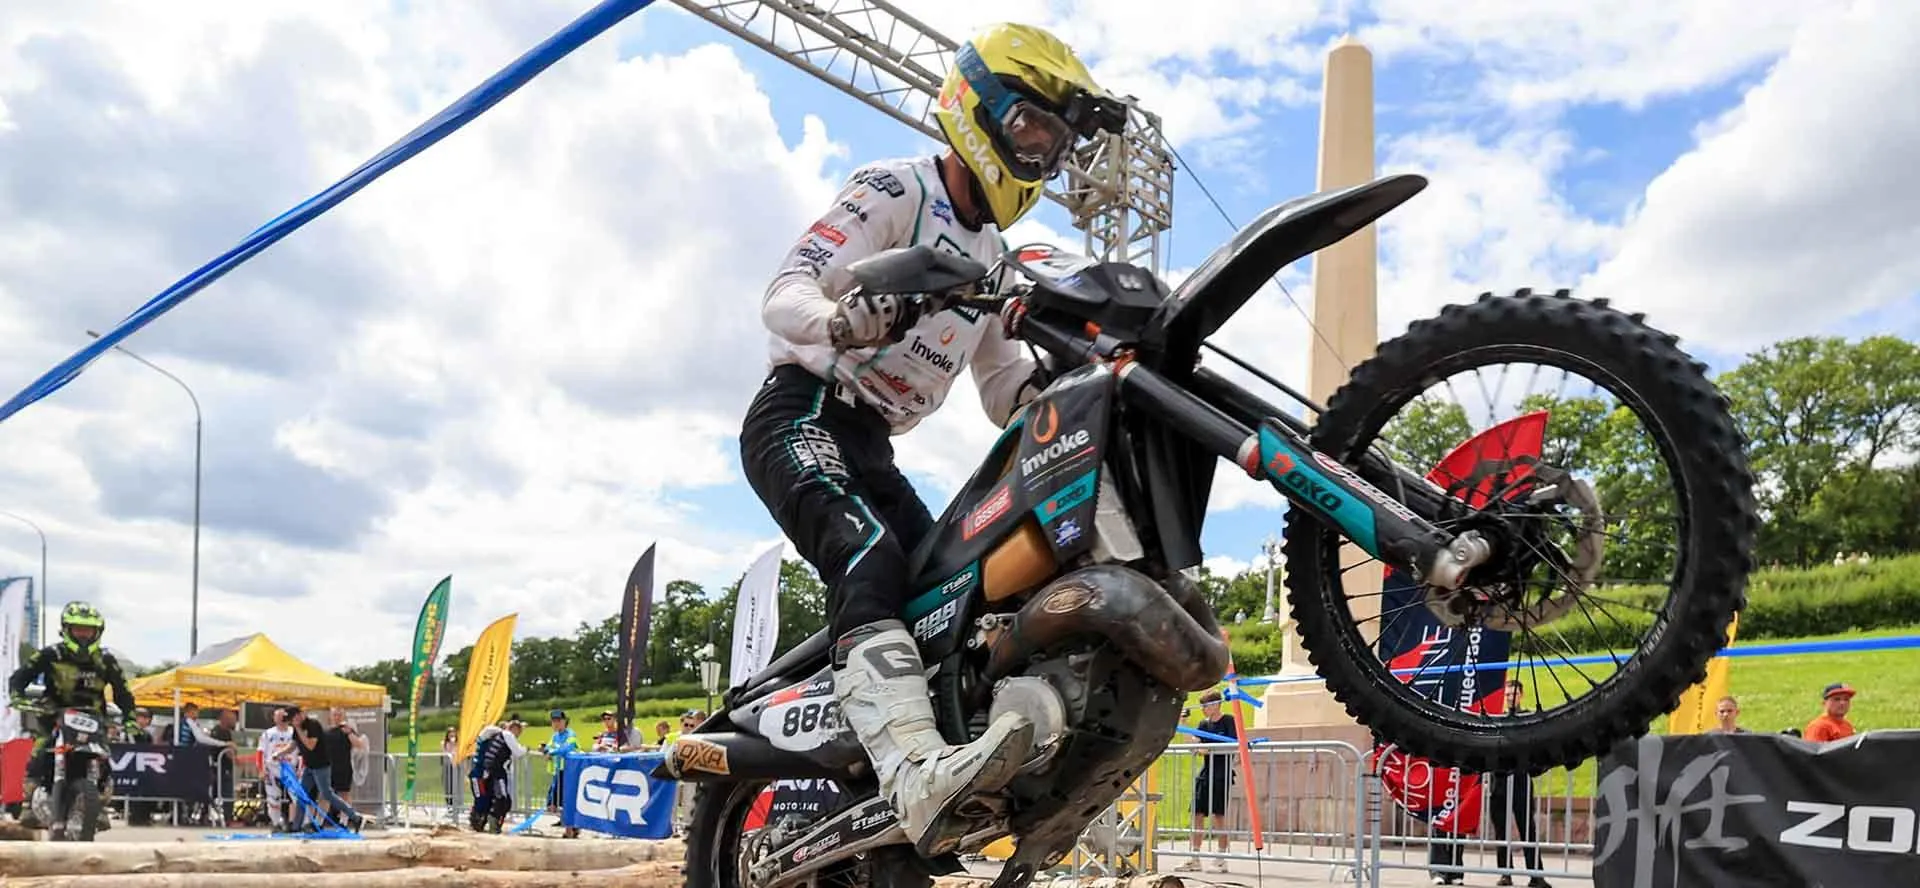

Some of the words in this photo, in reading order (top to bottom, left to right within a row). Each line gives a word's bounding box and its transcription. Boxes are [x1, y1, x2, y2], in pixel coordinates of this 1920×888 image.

[911, 335, 953, 374] invoke
[1021, 430, 1090, 476] invoke
[922, 620, 950, 641] TEAM
[108, 751, 166, 774] VR
[577, 765, 652, 826] GR
[1779, 800, 1920, 855] ZO
